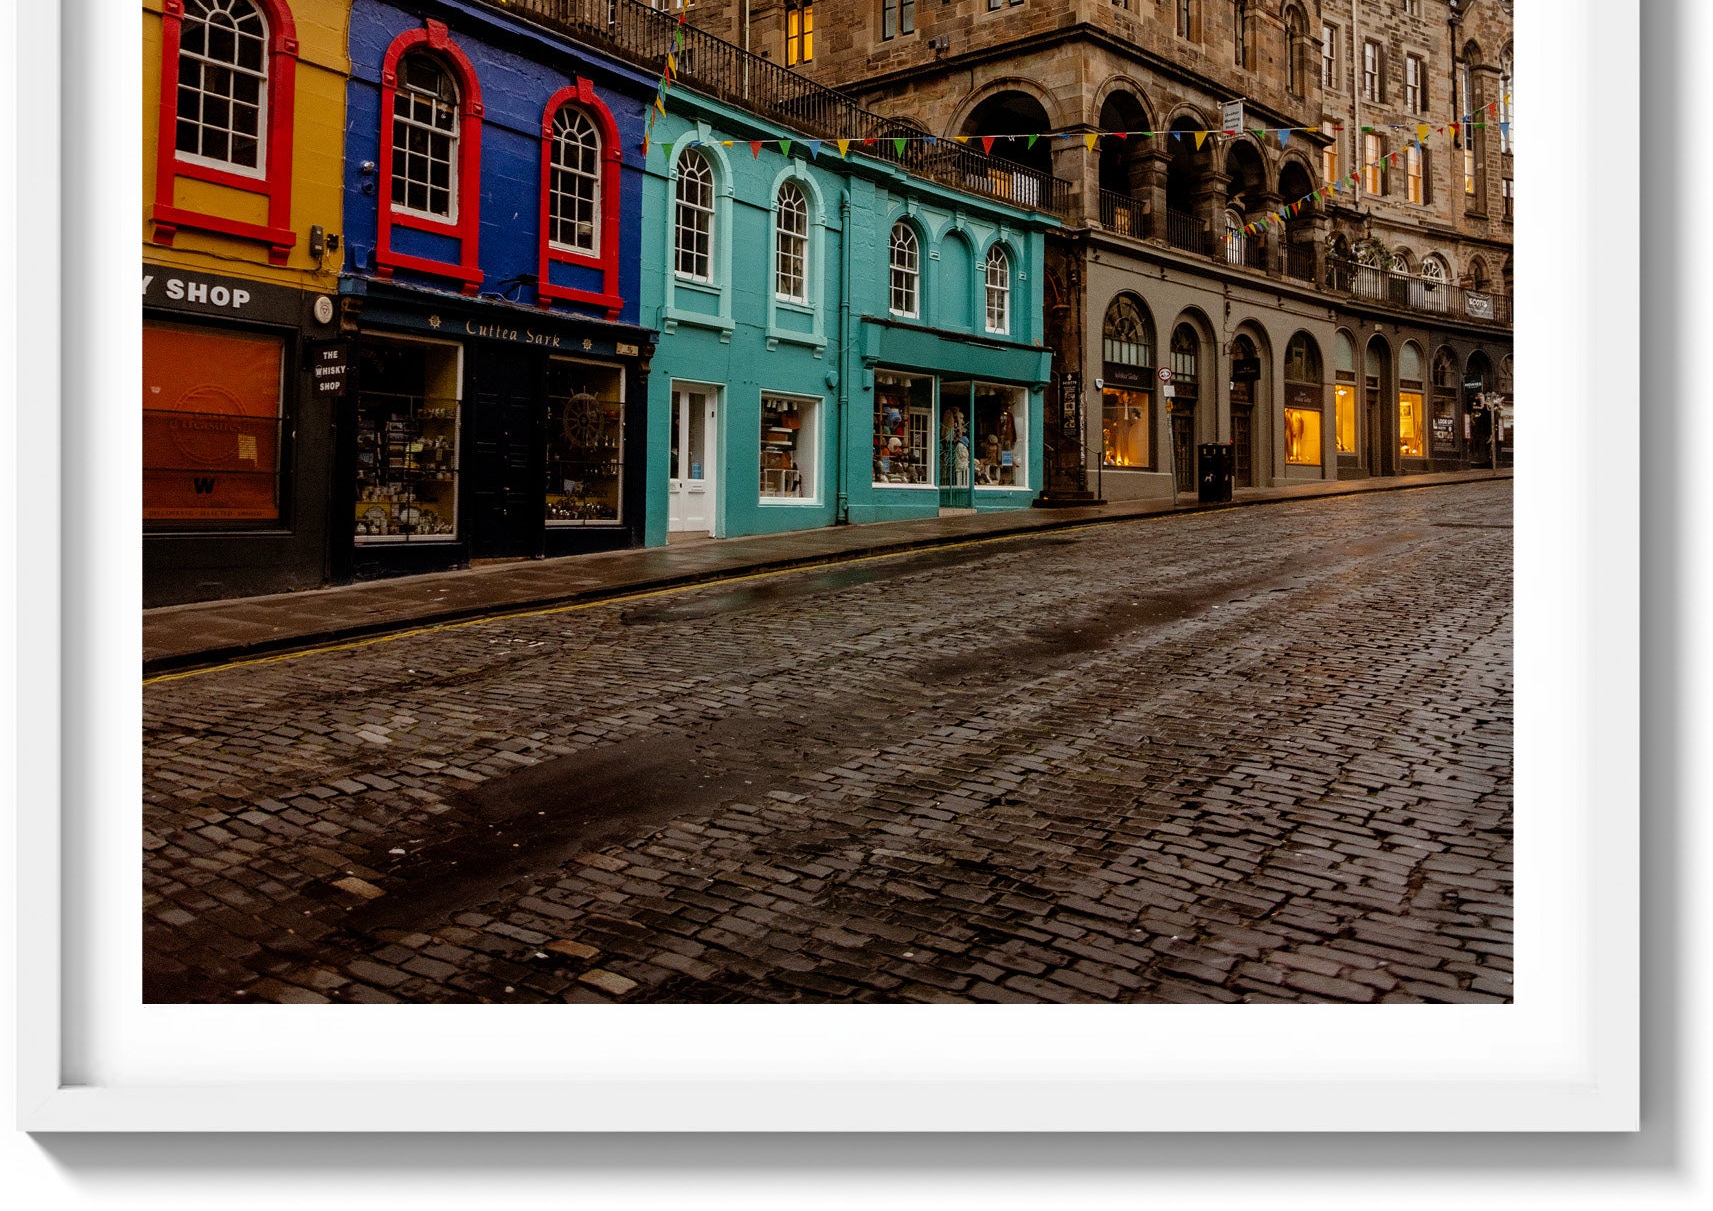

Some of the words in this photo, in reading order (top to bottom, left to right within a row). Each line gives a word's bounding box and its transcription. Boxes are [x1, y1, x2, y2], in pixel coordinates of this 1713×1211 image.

[165, 278, 251, 308] SHOP
[465, 320, 518, 341] Cuttea
[526, 328, 561, 348] Sark
[322, 350, 339, 360] THE
[315, 365, 346, 376] WHISKY
[319, 381, 341, 391] SHOP
[193, 477, 215, 494] W
